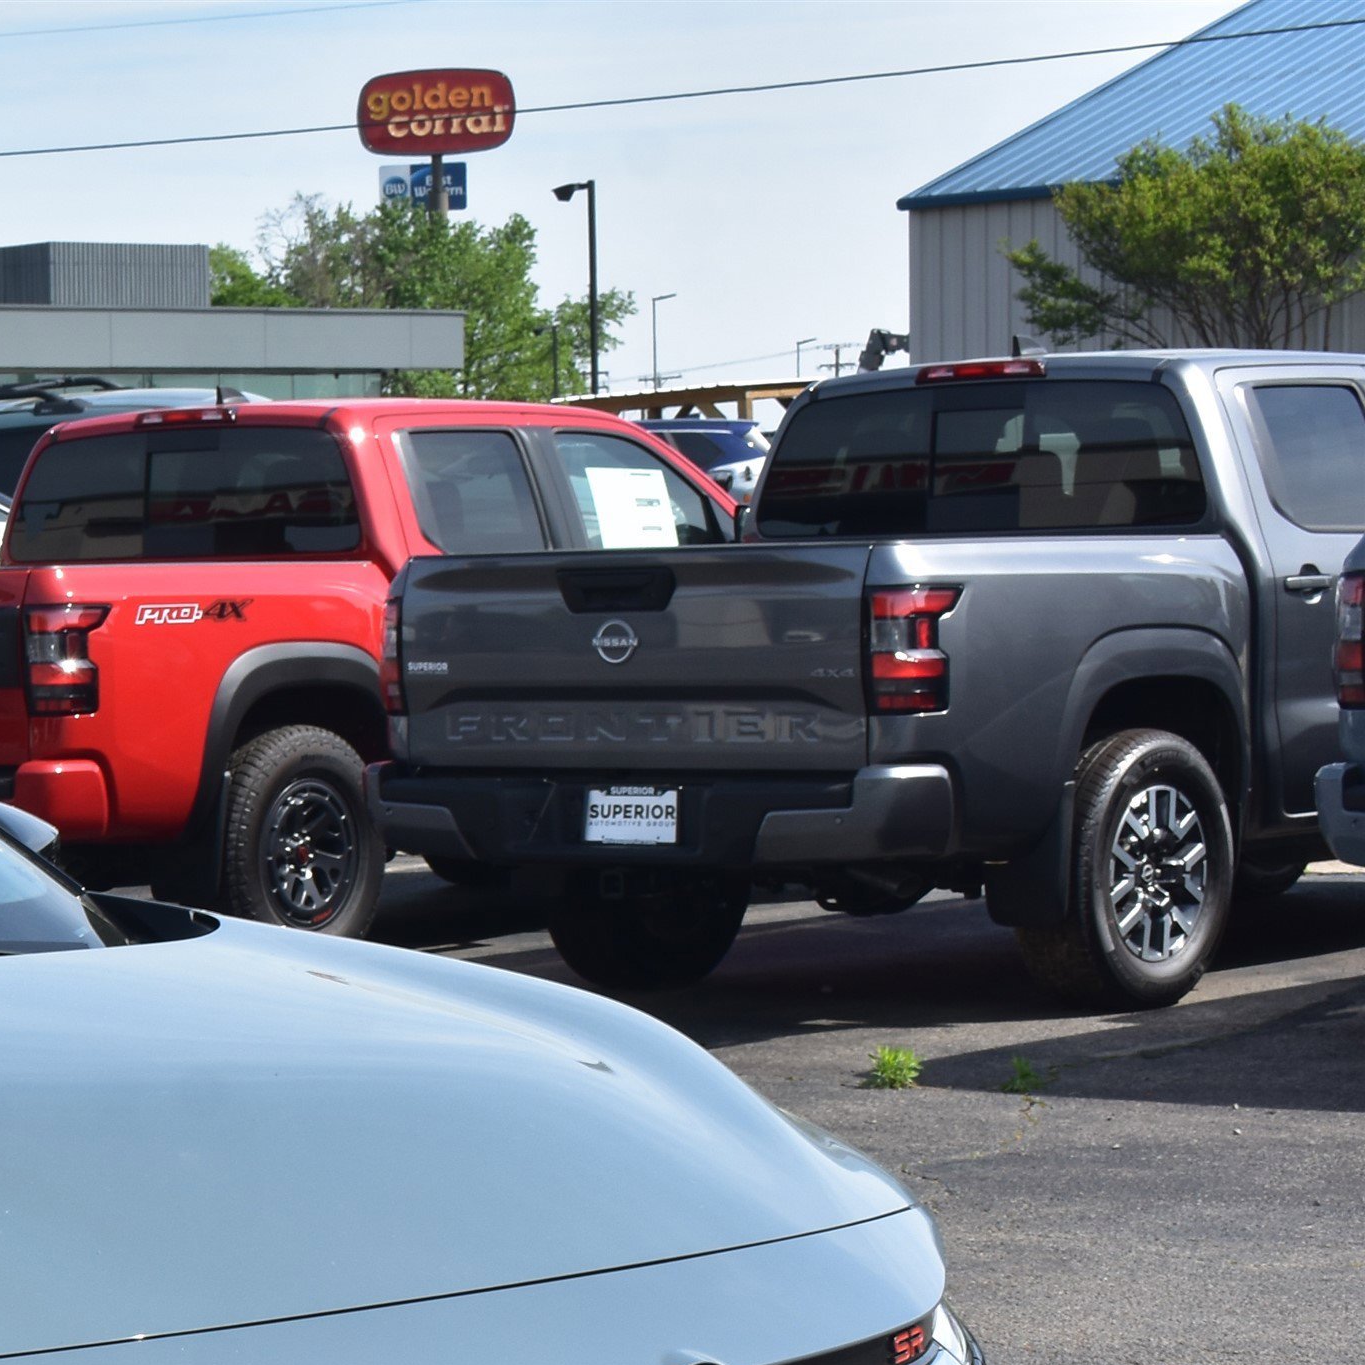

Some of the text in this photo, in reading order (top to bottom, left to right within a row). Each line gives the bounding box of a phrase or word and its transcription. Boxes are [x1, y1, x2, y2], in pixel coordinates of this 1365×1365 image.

[367, 82, 494, 121] golden
[387, 104, 506, 138] corral
[425, 174, 452, 187] Bst
[592, 637, 639, 647] NISSAN
[407, 661, 449, 672] SUPERIOR
[445, 710, 820, 743] FRONTIER
[610, 785, 655, 796] SUPERIOR
[589, 804, 676, 819] SUPERIOR
[893, 1325, 925, 1365] SR
